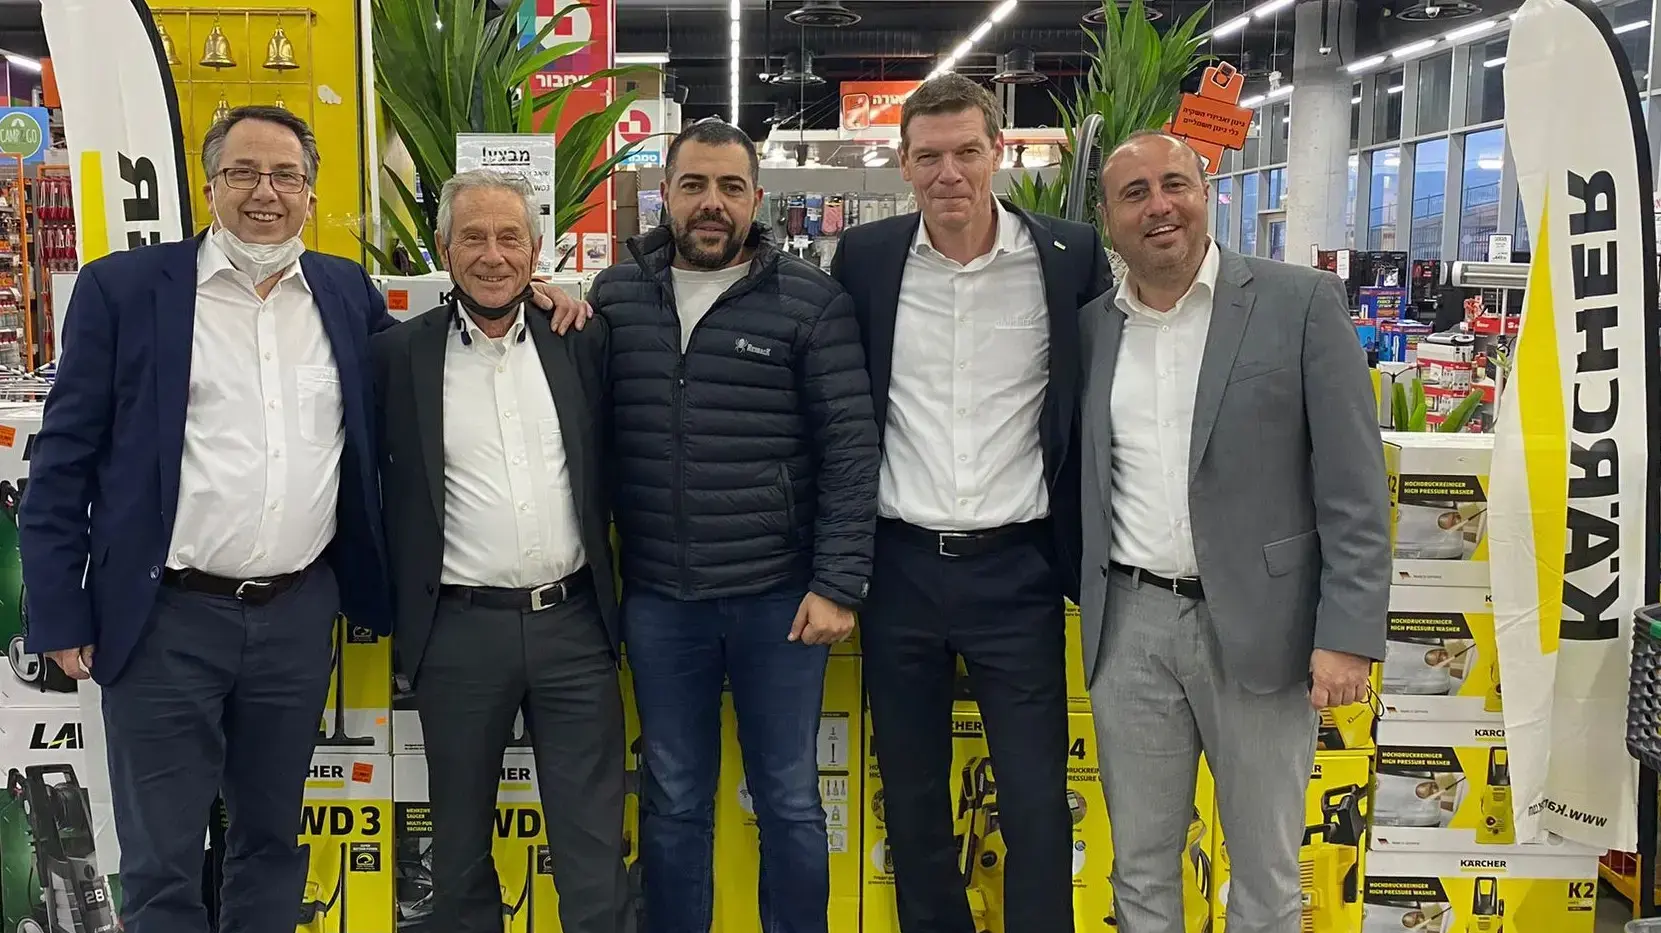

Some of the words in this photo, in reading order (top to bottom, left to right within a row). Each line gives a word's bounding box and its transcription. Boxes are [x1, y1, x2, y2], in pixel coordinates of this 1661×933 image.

[1069, 738, 1086, 759] 4
[361, 805, 381, 836] 3
[85, 889, 105, 904] 28
